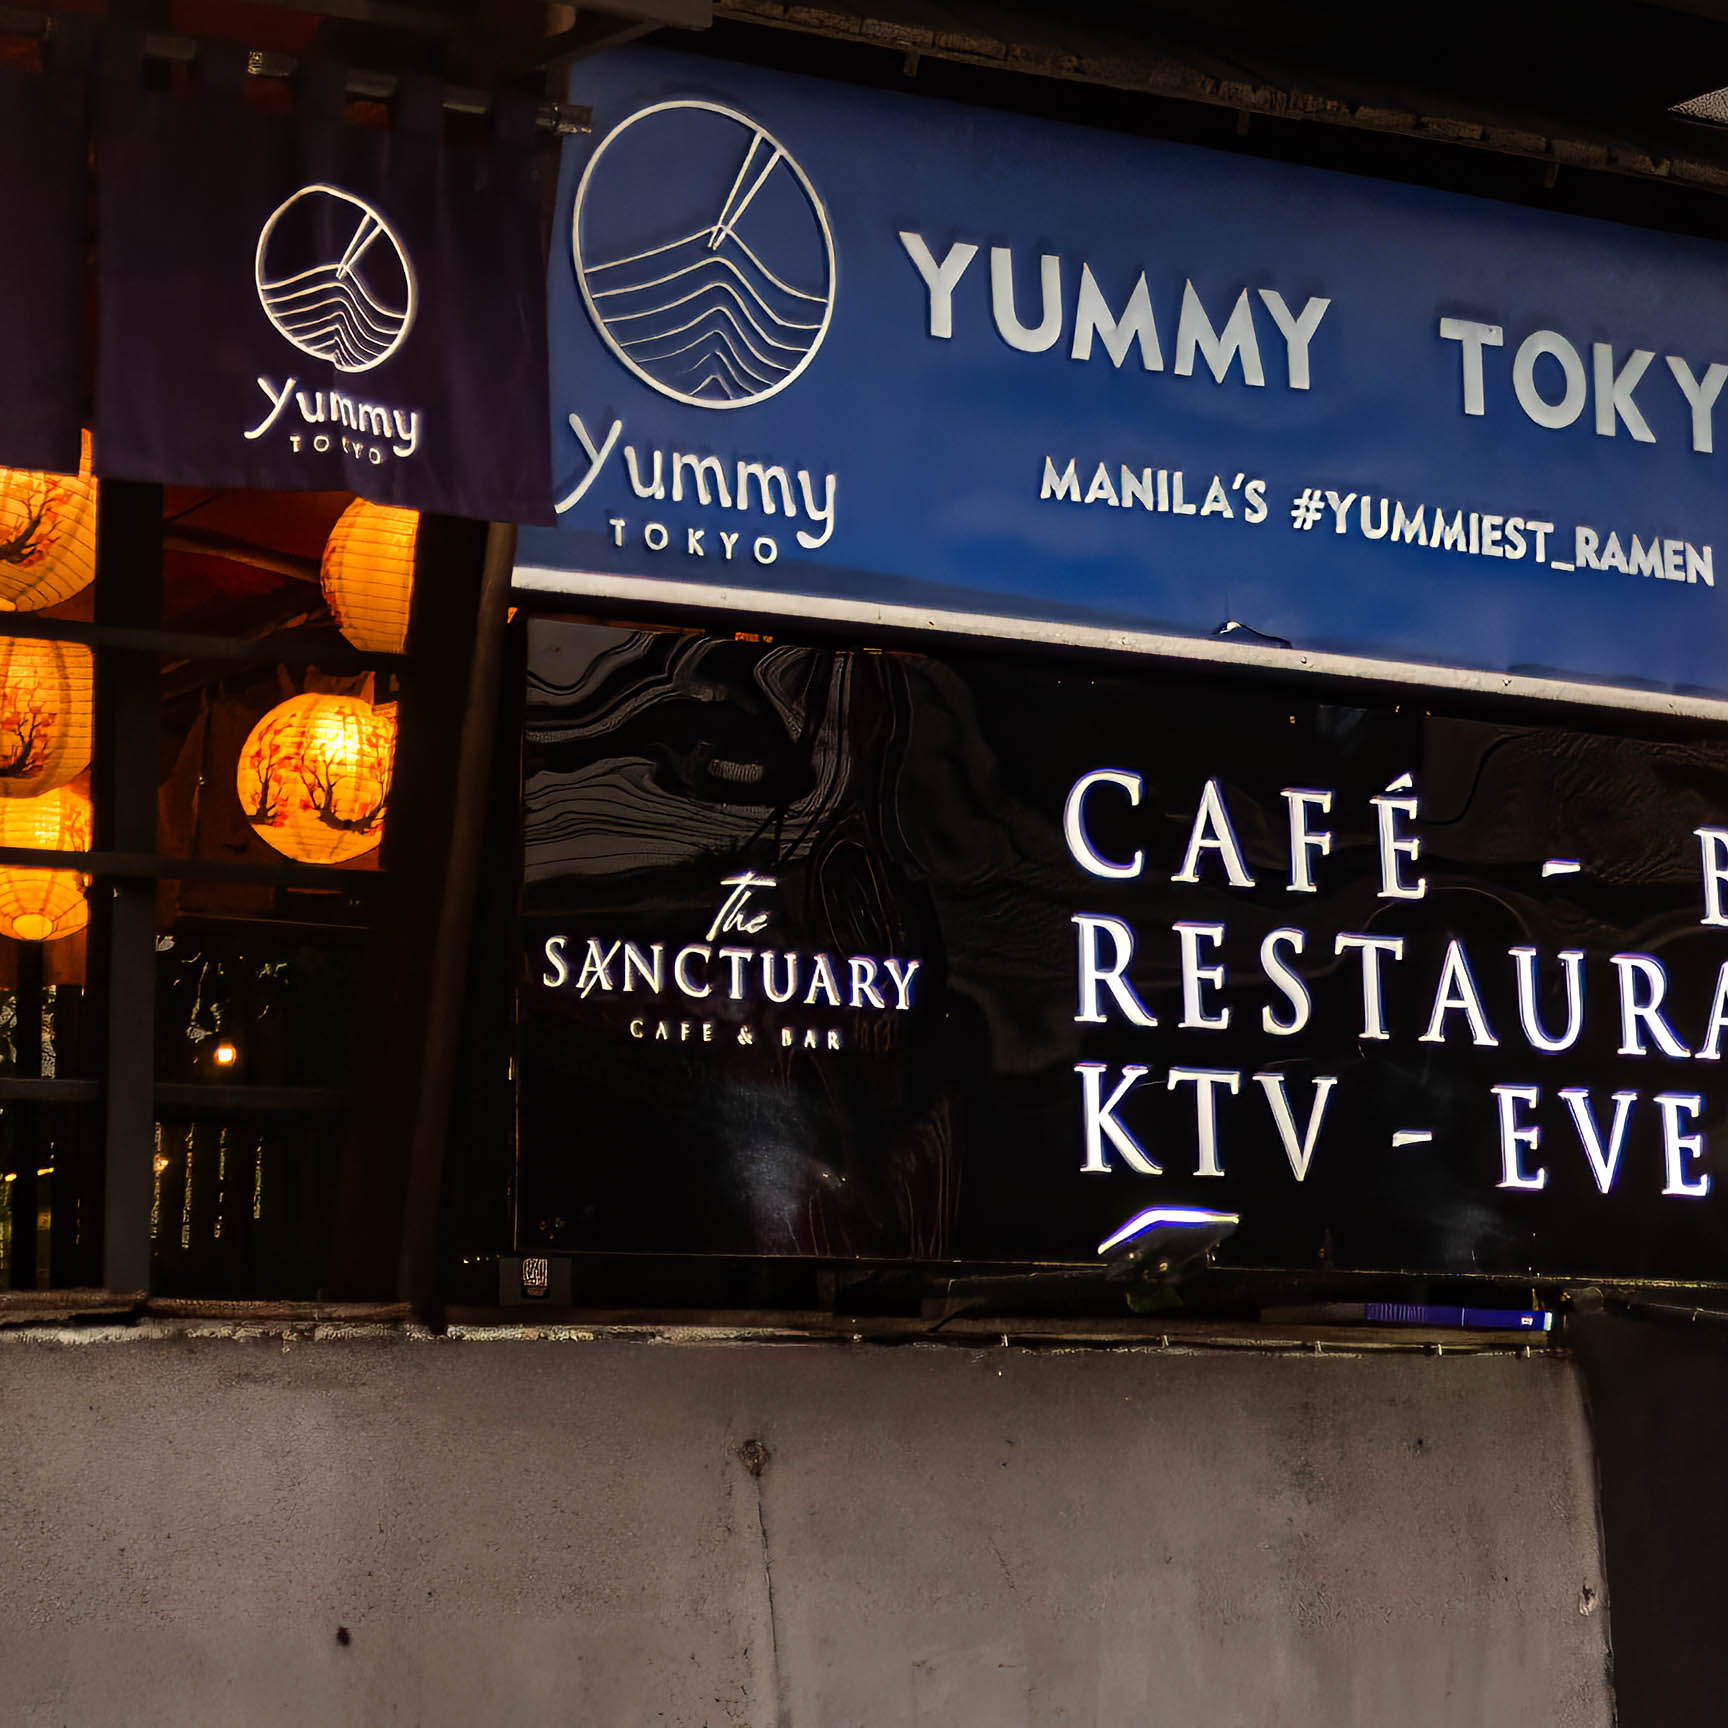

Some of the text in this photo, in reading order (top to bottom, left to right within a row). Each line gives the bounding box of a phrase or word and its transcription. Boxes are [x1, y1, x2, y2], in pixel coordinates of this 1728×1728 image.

[898, 229, 1331, 391] YUMMY
[609, 518, 778, 564] TOKYO
[1039, 455, 1715, 588] MANILA'S #YUMMIEST_RAMEN
[1062, 767, 1427, 901] CAFÉ
[705, 871, 777, 942] The
[542, 935, 922, 1010] SANCTUARY
[629, 1019, 841, 1050] CAFE & BAR
[1073, 1061, 1338, 1183] KTV
